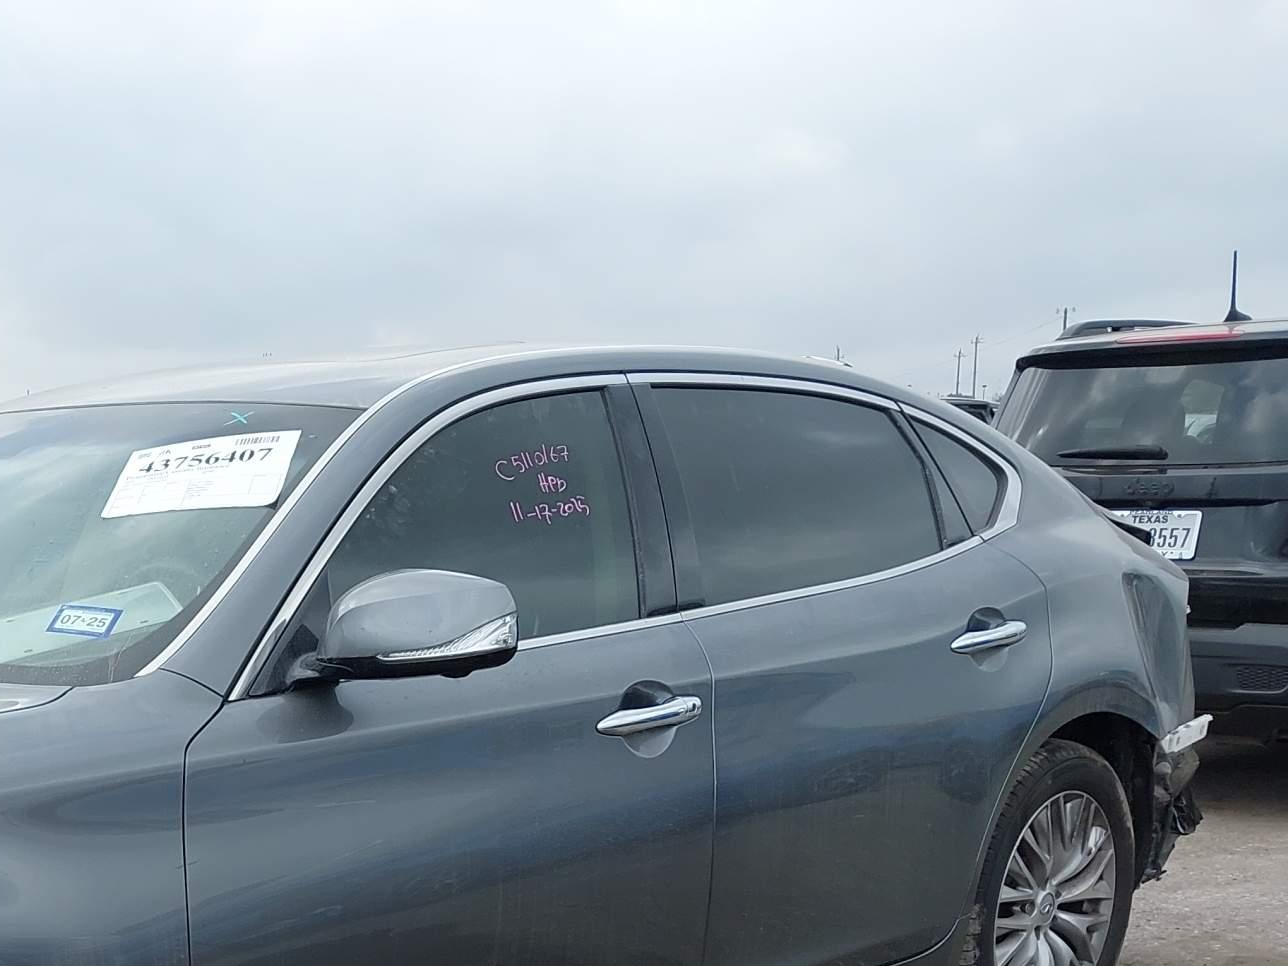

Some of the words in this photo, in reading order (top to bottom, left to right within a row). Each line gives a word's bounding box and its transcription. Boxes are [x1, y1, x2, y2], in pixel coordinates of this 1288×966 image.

[139, 447, 274, 474] 43756407
[537, 472, 567, 493] HPD
[1132, 515, 1169, 524] TEXAS
[60, 614, 82, 625] 07
[86, 616, 109, 628] 25
